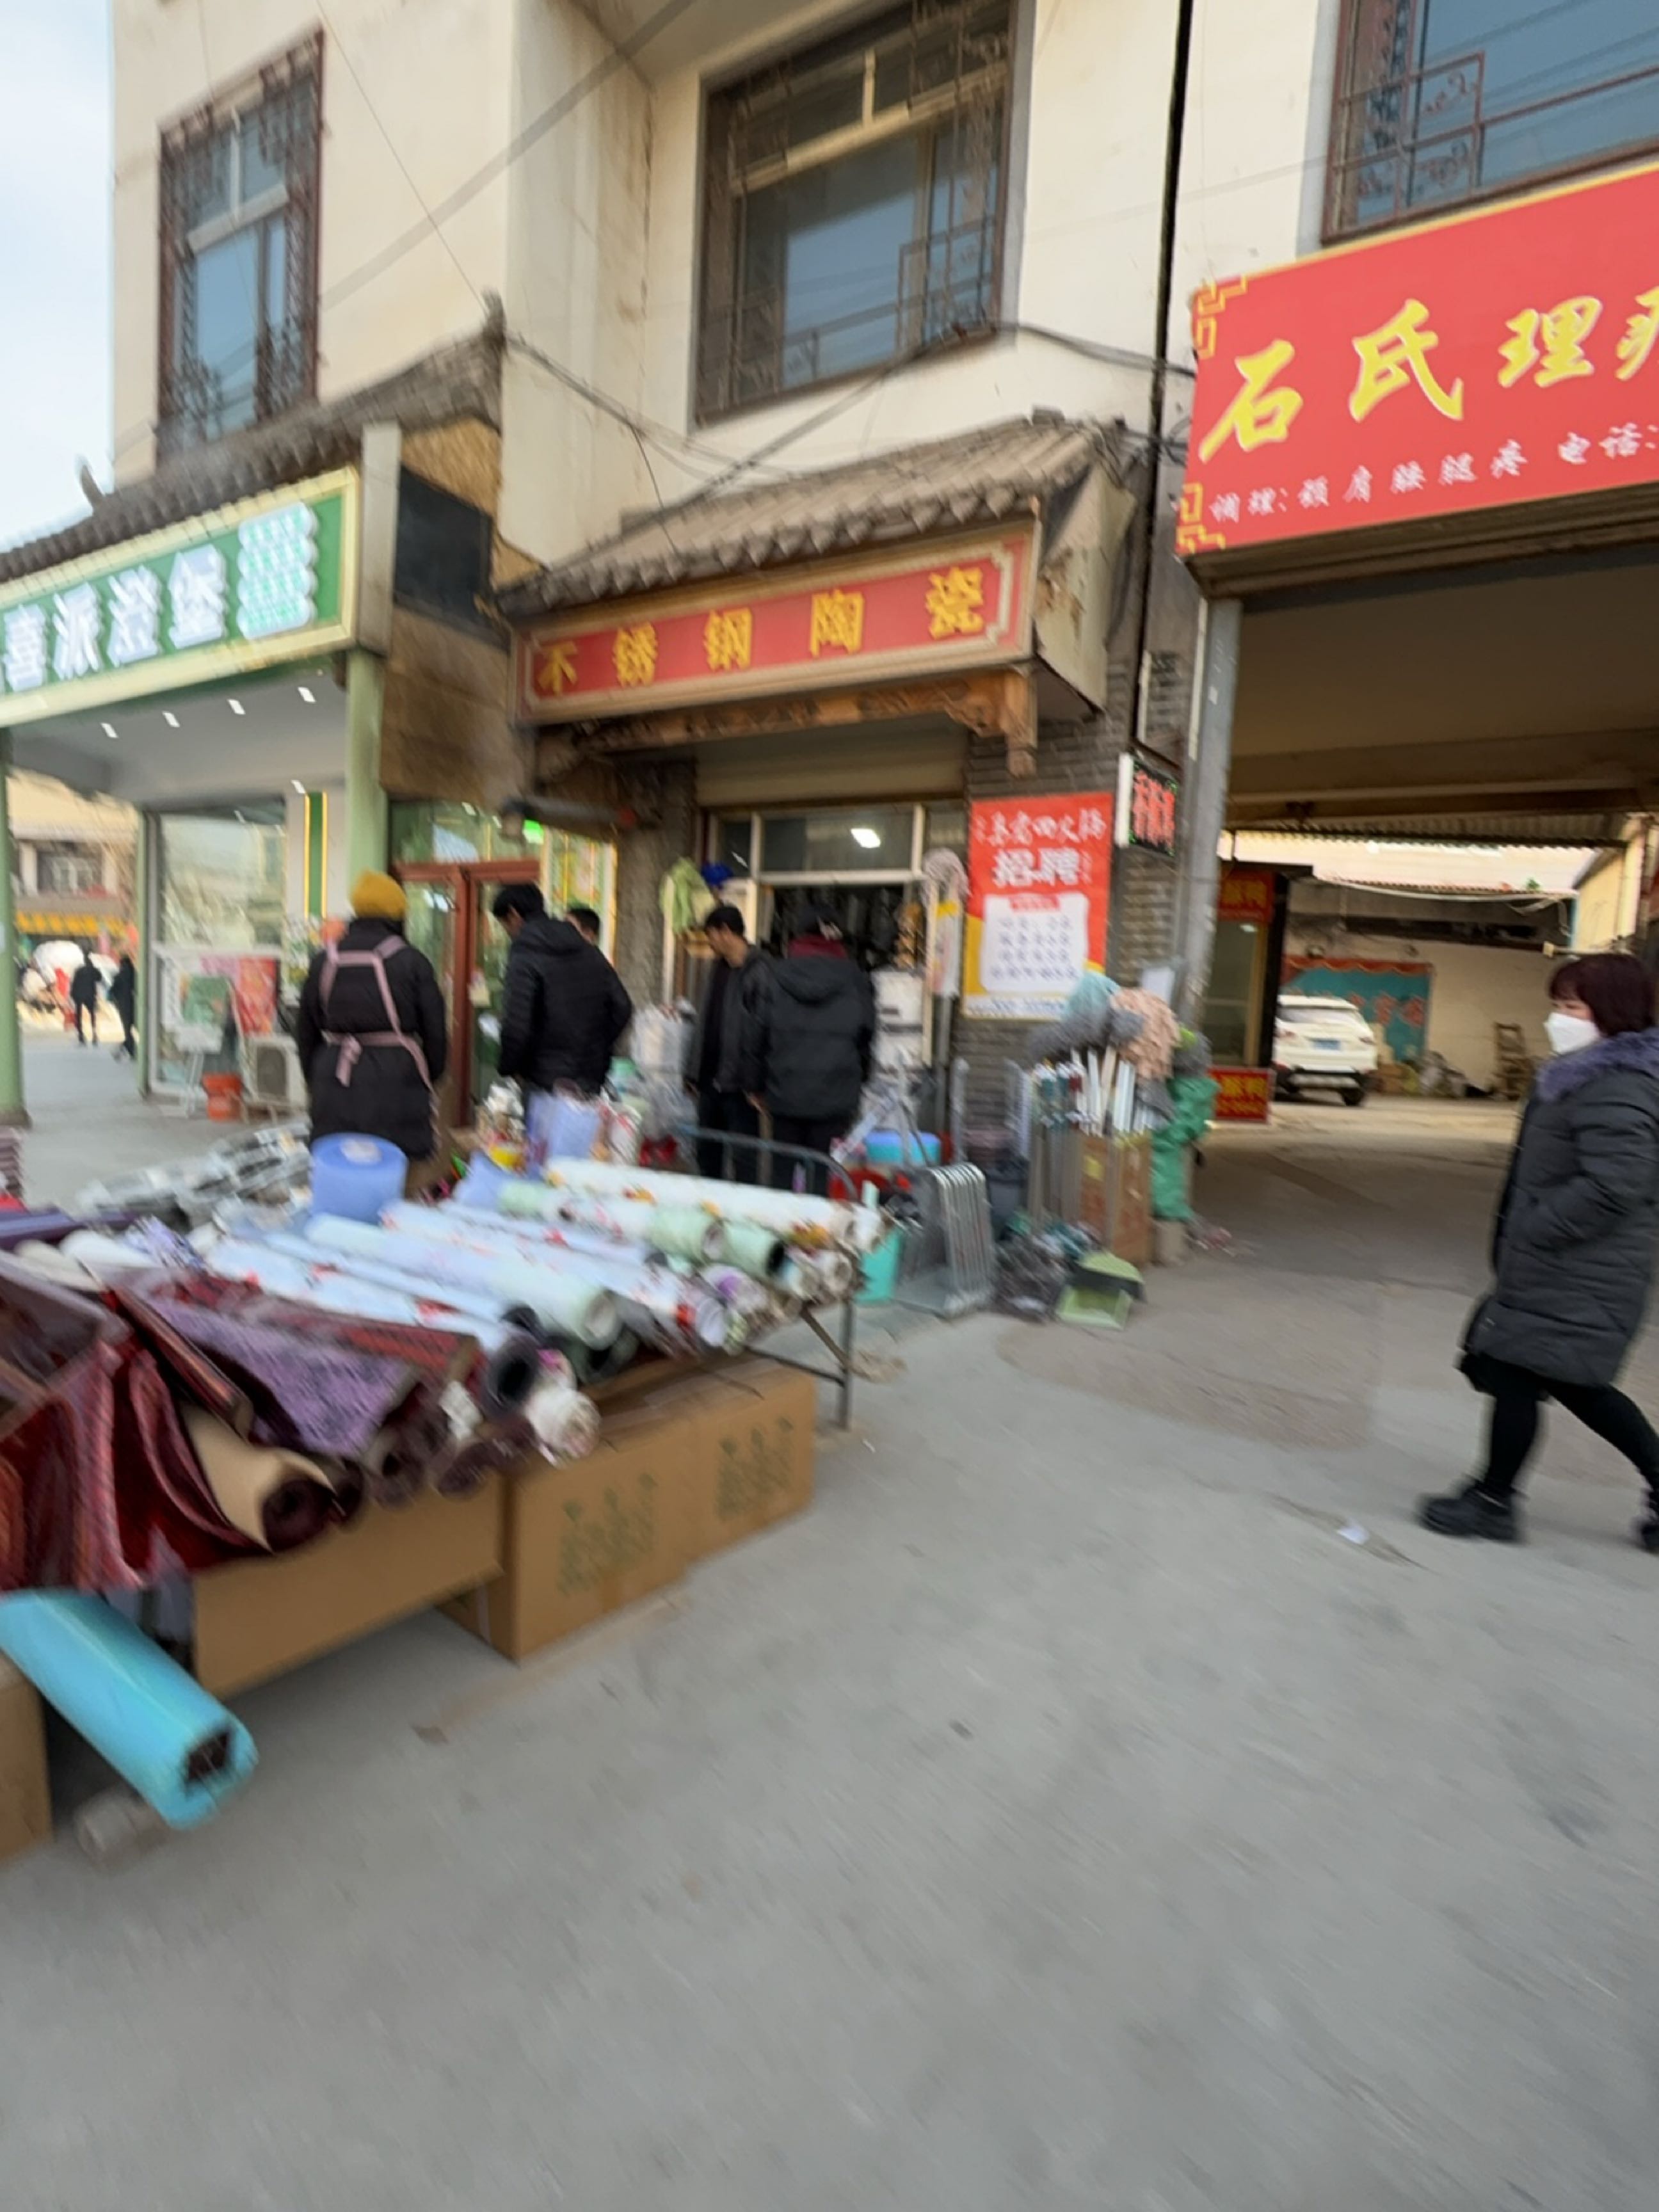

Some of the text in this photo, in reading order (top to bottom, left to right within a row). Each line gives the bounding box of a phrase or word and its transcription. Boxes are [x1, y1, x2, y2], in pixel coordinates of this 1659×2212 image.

[537, 566, 984, 695] 不锈钢陶瓷
